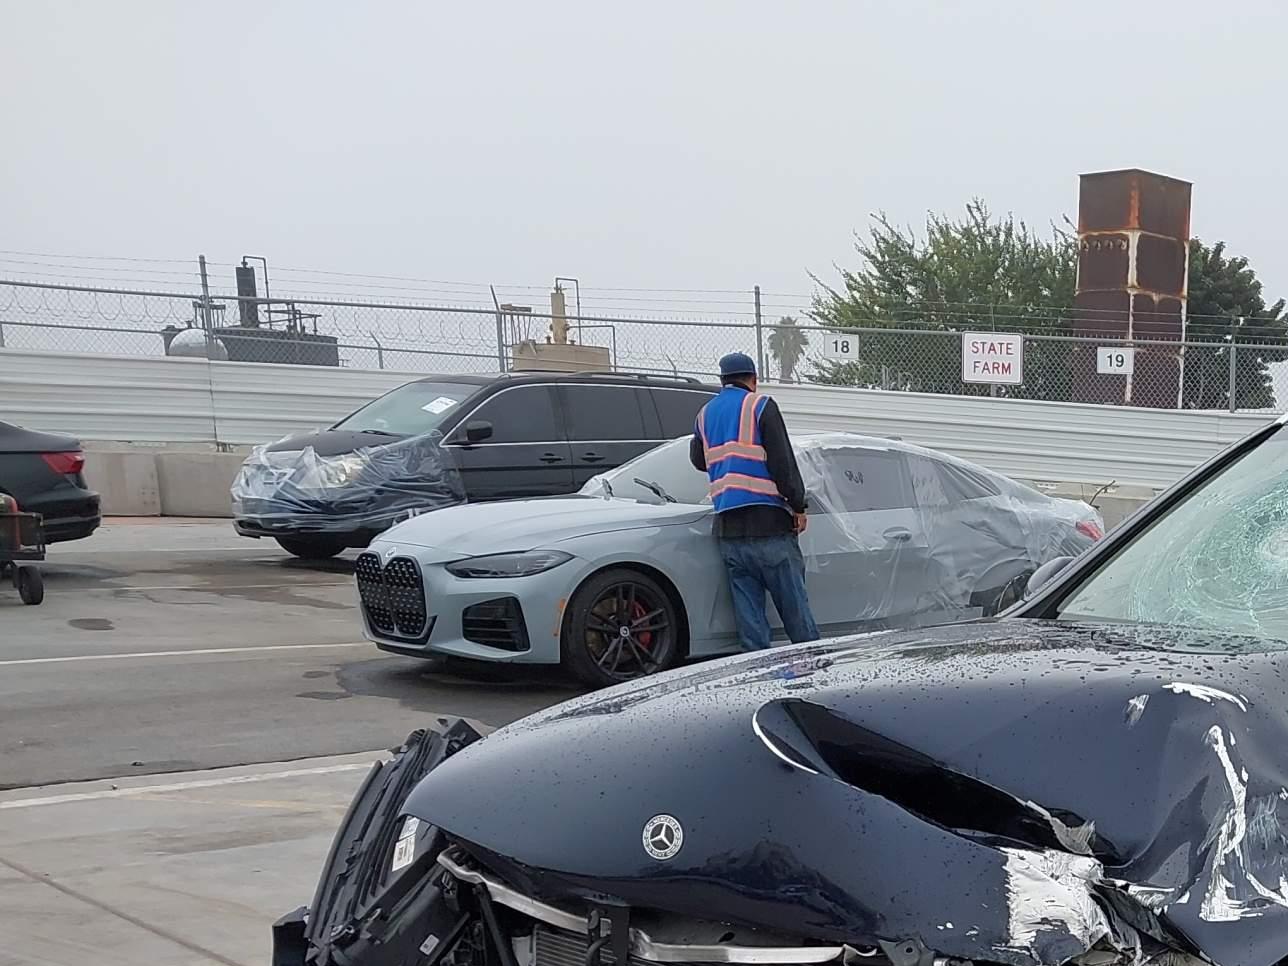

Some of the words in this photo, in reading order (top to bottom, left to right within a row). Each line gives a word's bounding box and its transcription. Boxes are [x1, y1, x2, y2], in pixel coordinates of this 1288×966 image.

[831, 339, 850, 354] 18
[971, 340, 1015, 356] STATE
[973, 360, 1012, 376] FARM
[1106, 353, 1125, 368] 19
